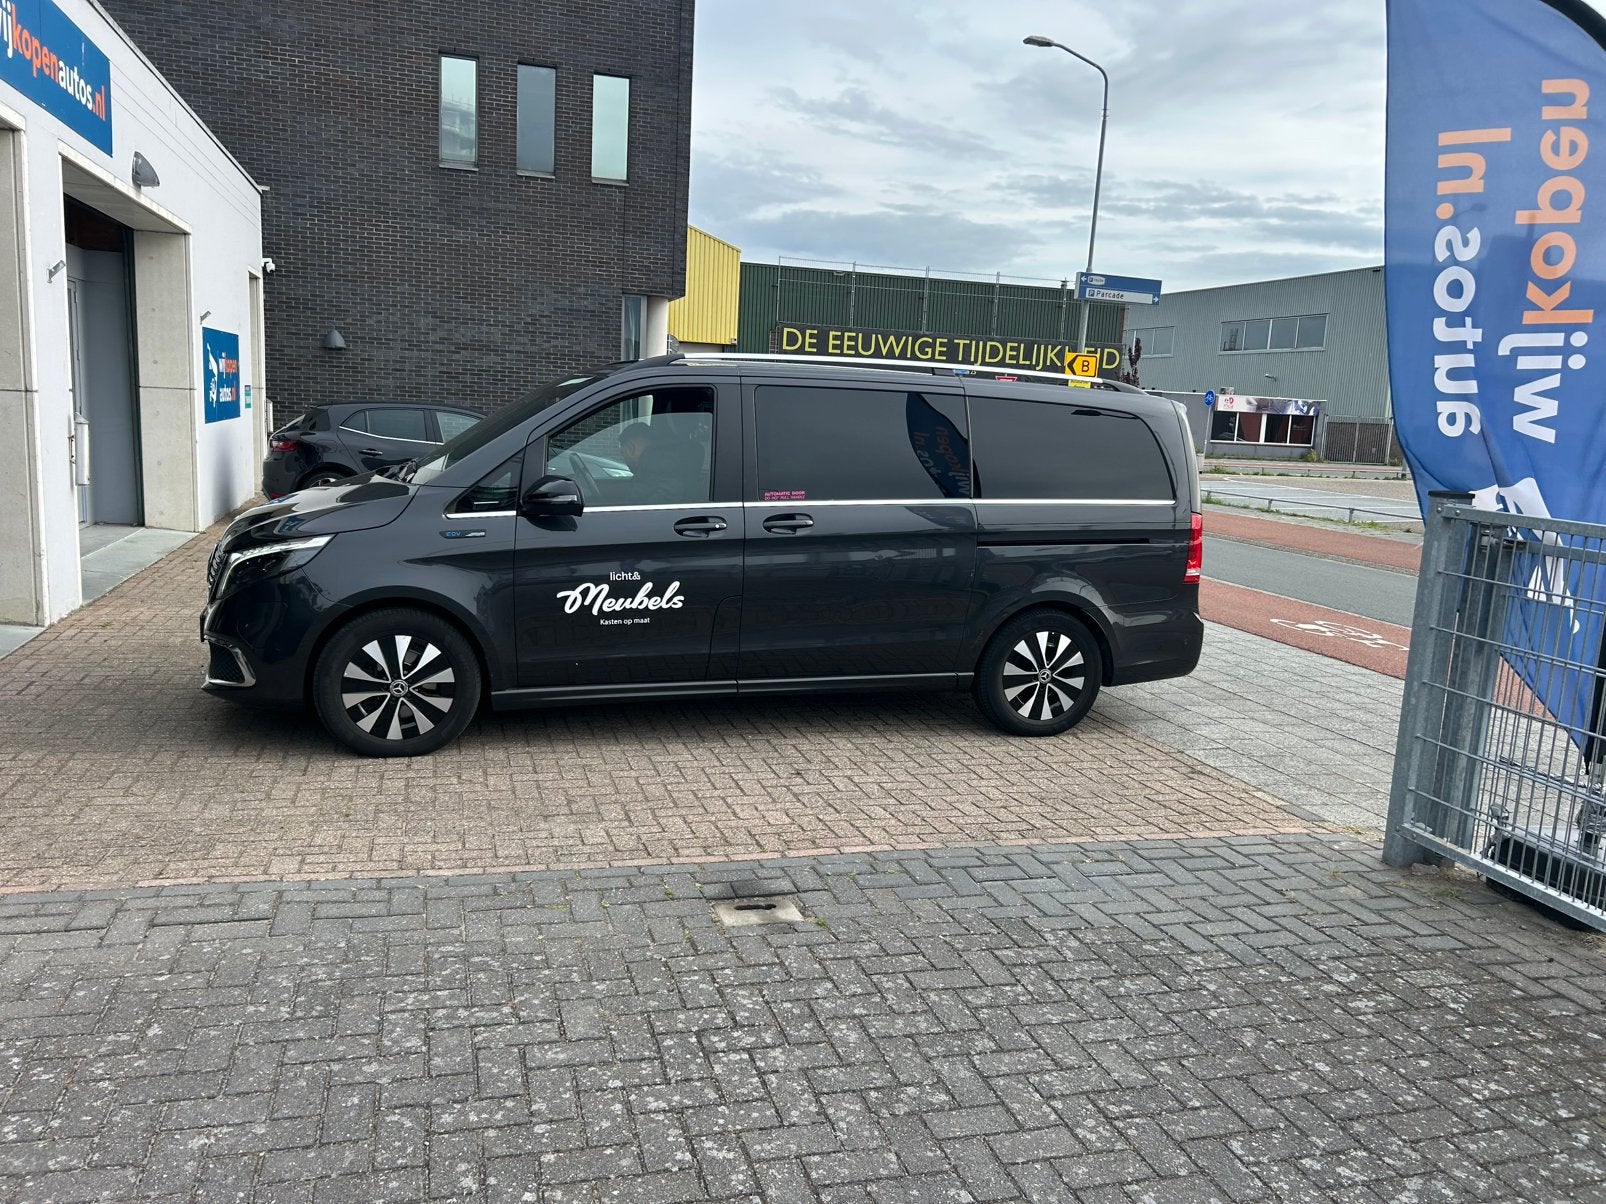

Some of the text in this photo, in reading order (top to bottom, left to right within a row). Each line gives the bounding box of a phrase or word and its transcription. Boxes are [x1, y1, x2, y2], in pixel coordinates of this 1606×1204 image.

[1096, 290, 1124, 299] Parcade
[782, 327, 818, 352] DE
[828, 331, 948, 360] EEUWIGE
[1081, 360, 1090, 373] B
[609, 571, 641, 581] licht&
[556, 581, 685, 616] Meubels
